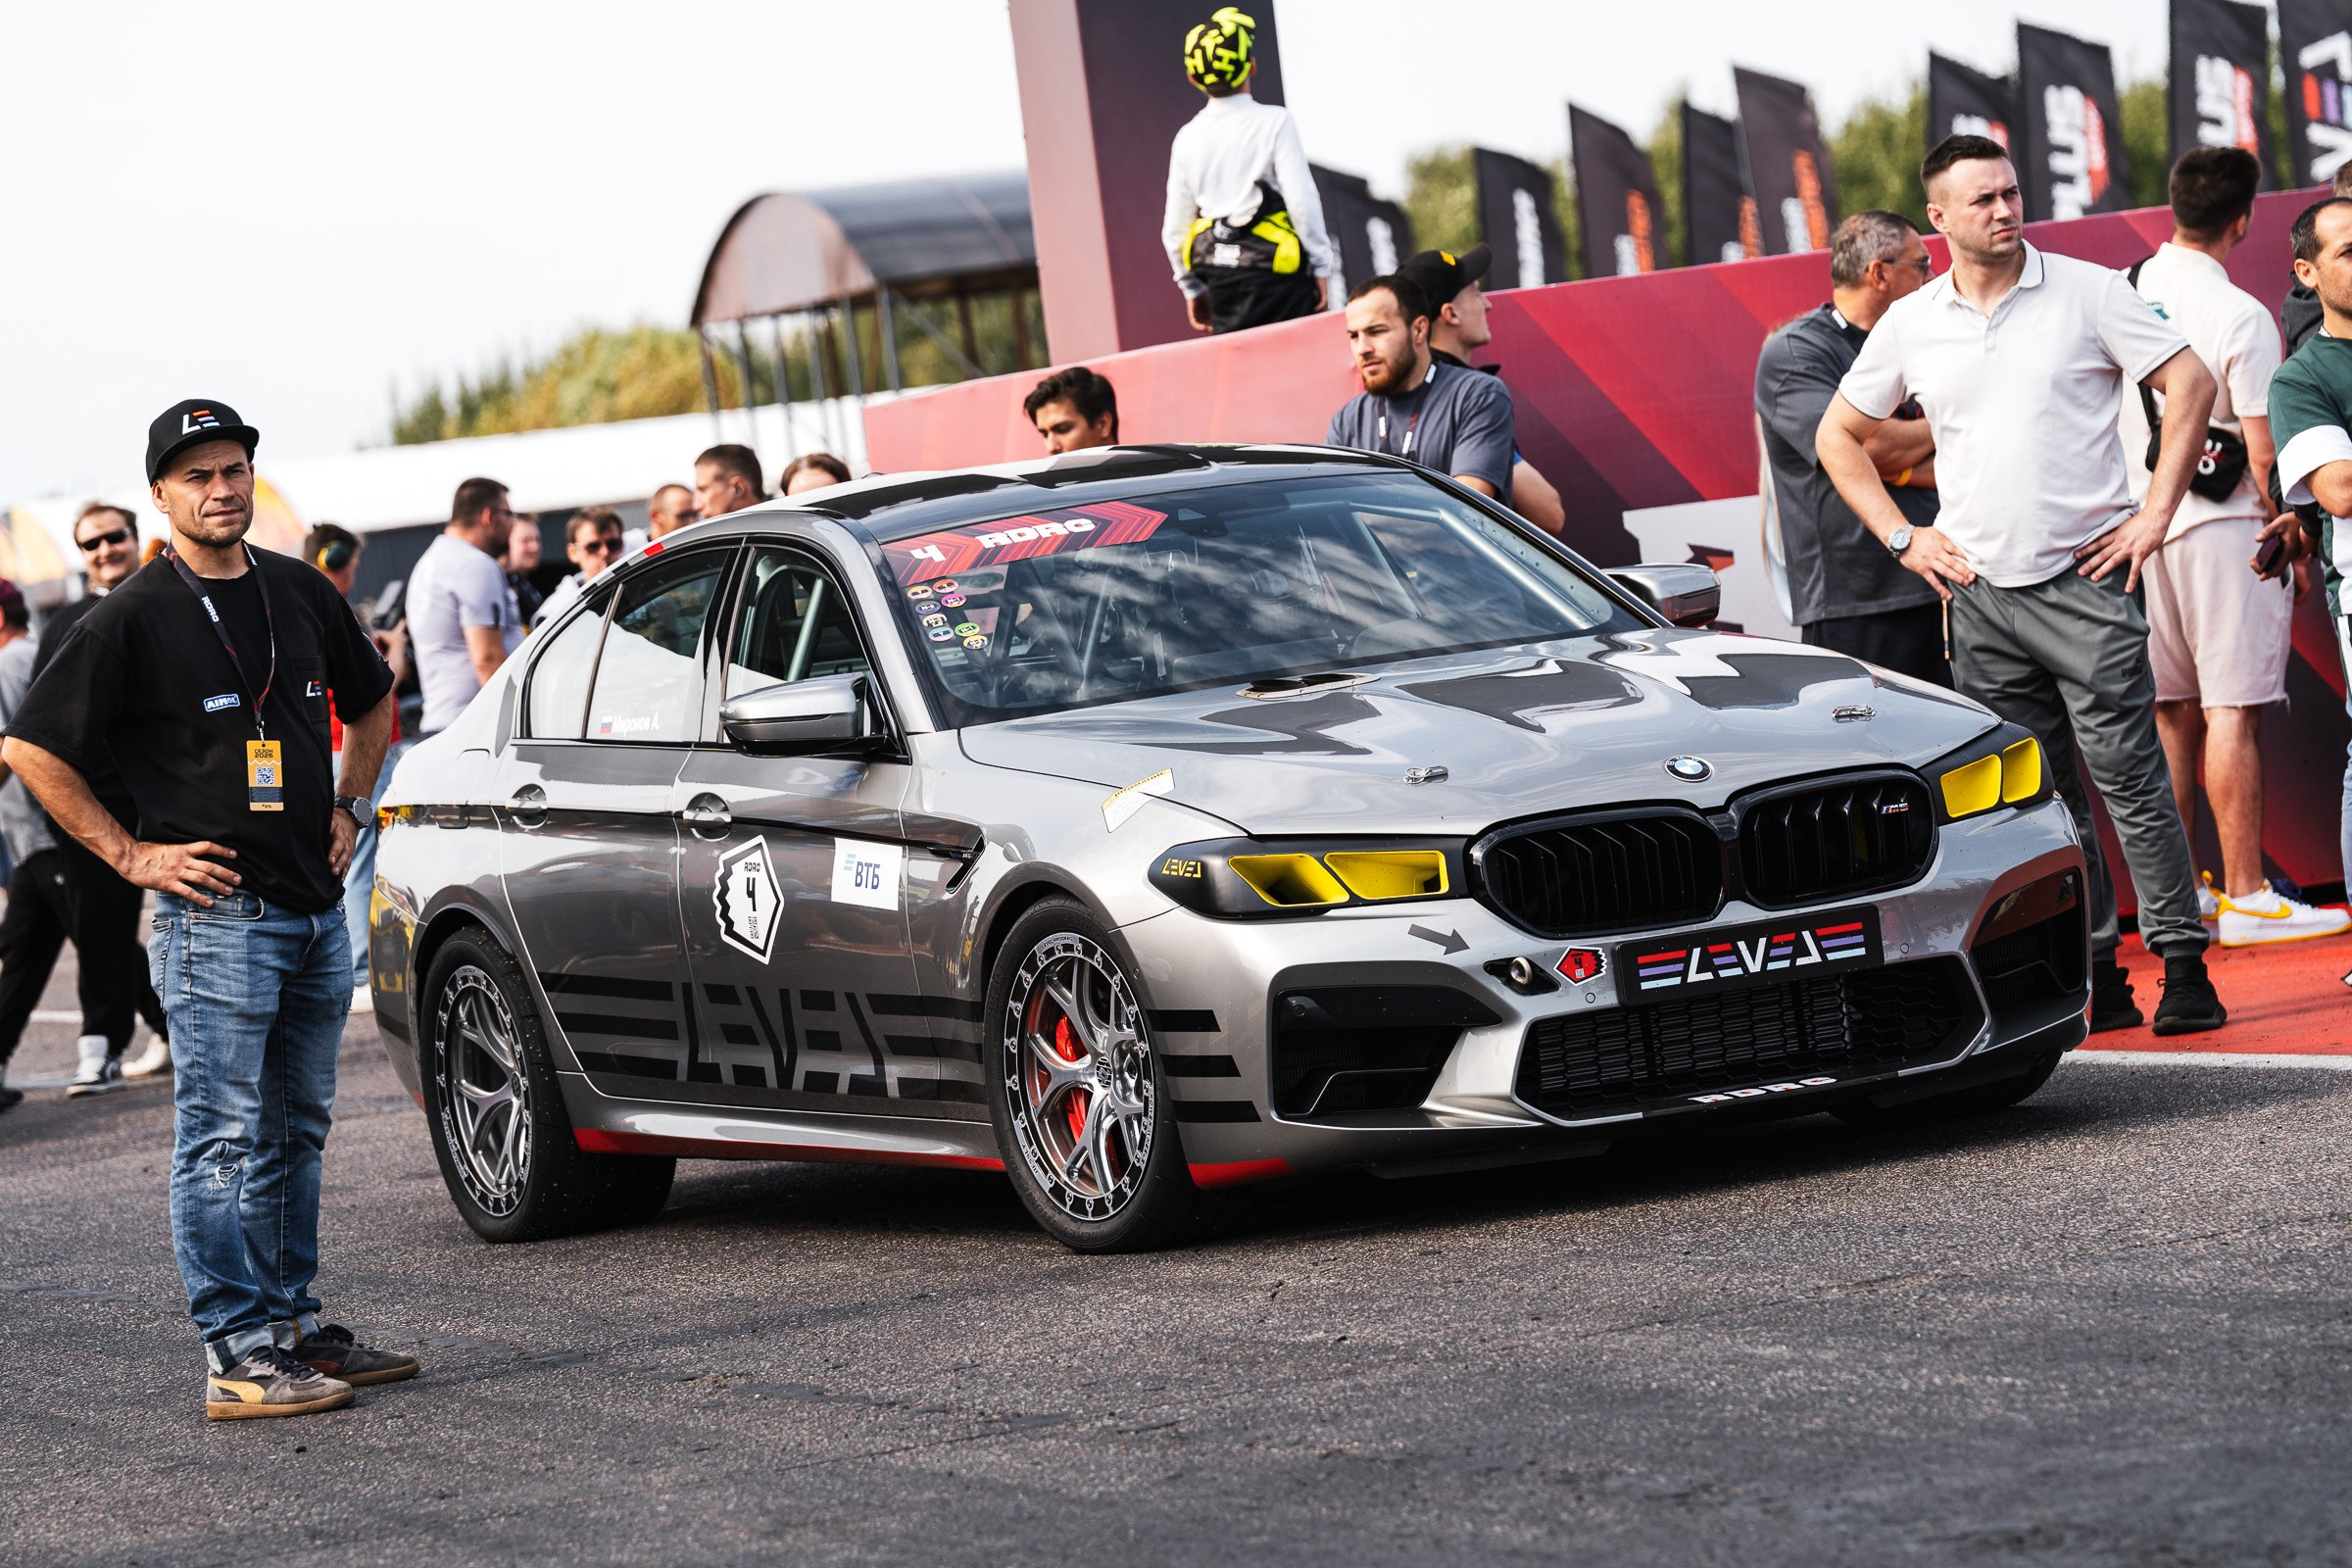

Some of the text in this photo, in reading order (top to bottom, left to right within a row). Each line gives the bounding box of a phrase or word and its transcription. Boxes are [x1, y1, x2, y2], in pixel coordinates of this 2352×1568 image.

[909, 518, 1097, 563] 4 RDRC
[855, 861, 880, 890] ВТБ
[1161, 858, 1201, 878] LEVEL
[746, 877, 757, 912] 4
